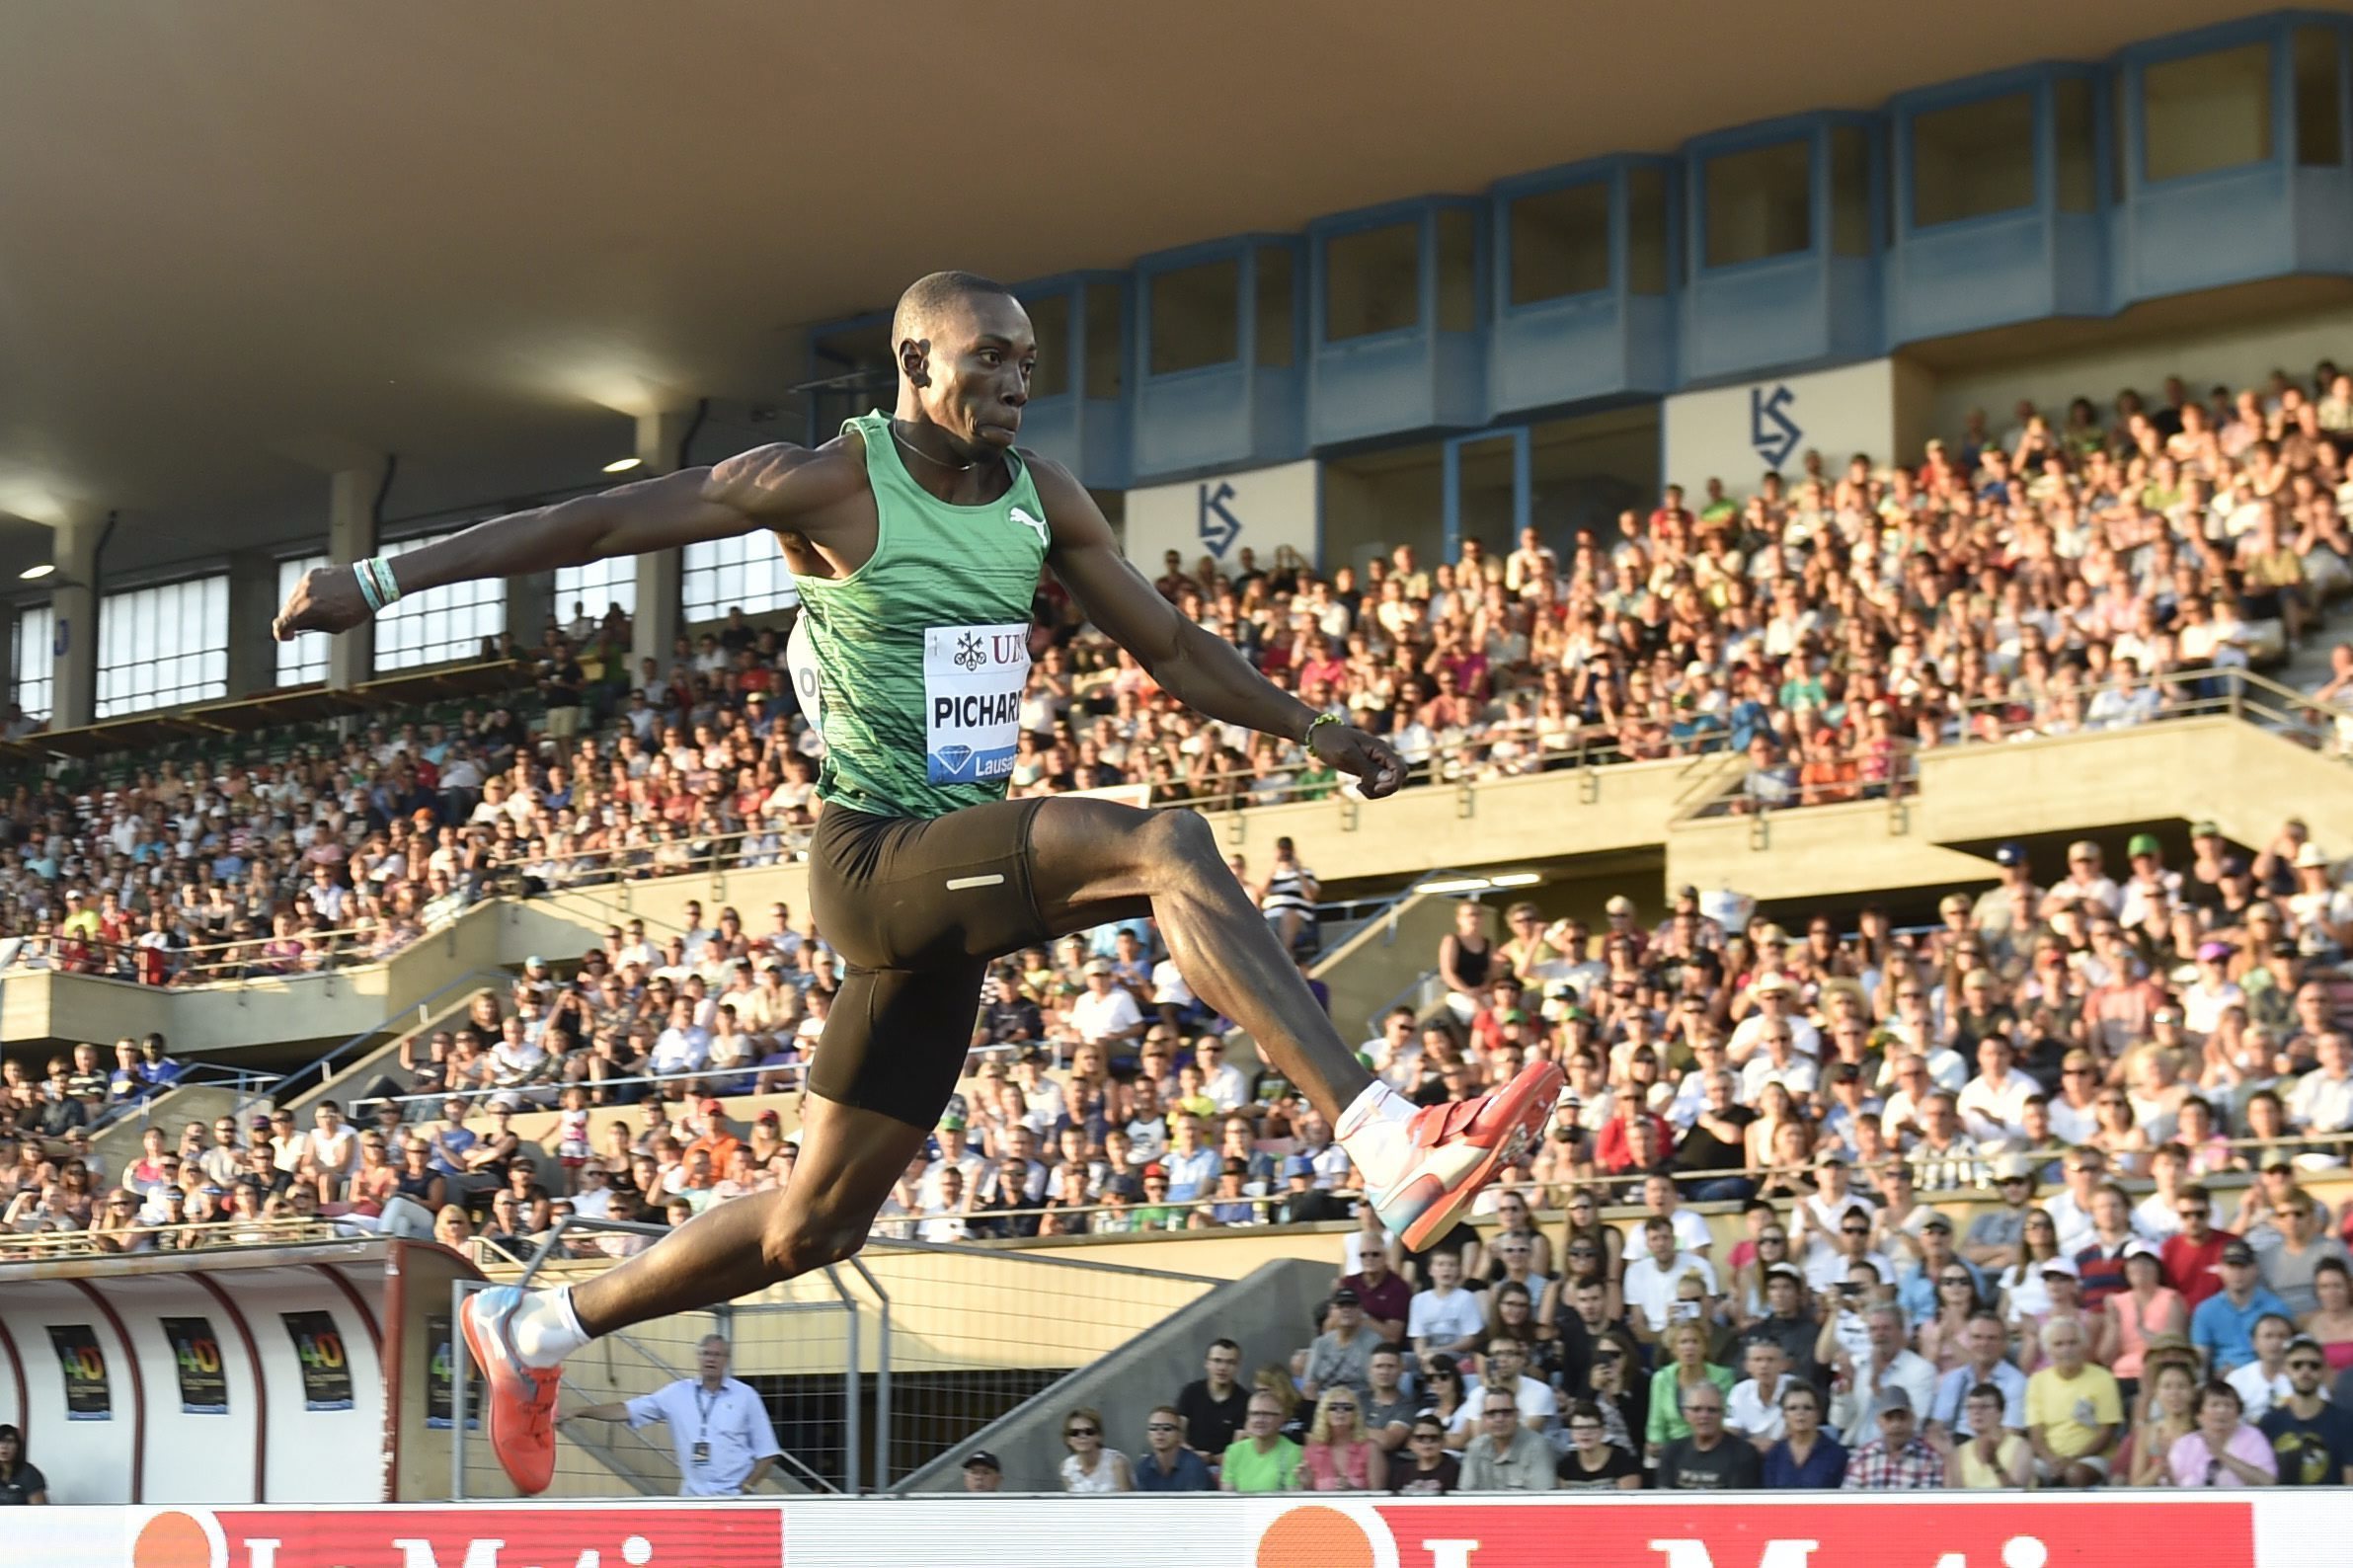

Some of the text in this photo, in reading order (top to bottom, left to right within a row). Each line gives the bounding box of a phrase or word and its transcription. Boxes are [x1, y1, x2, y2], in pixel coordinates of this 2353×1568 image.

[975, 753, 1017, 777] Lausa
[63, 1345, 105, 1381] 40
[177, 1338, 220, 1373] 40
[300, 1331, 344, 1369] 40
